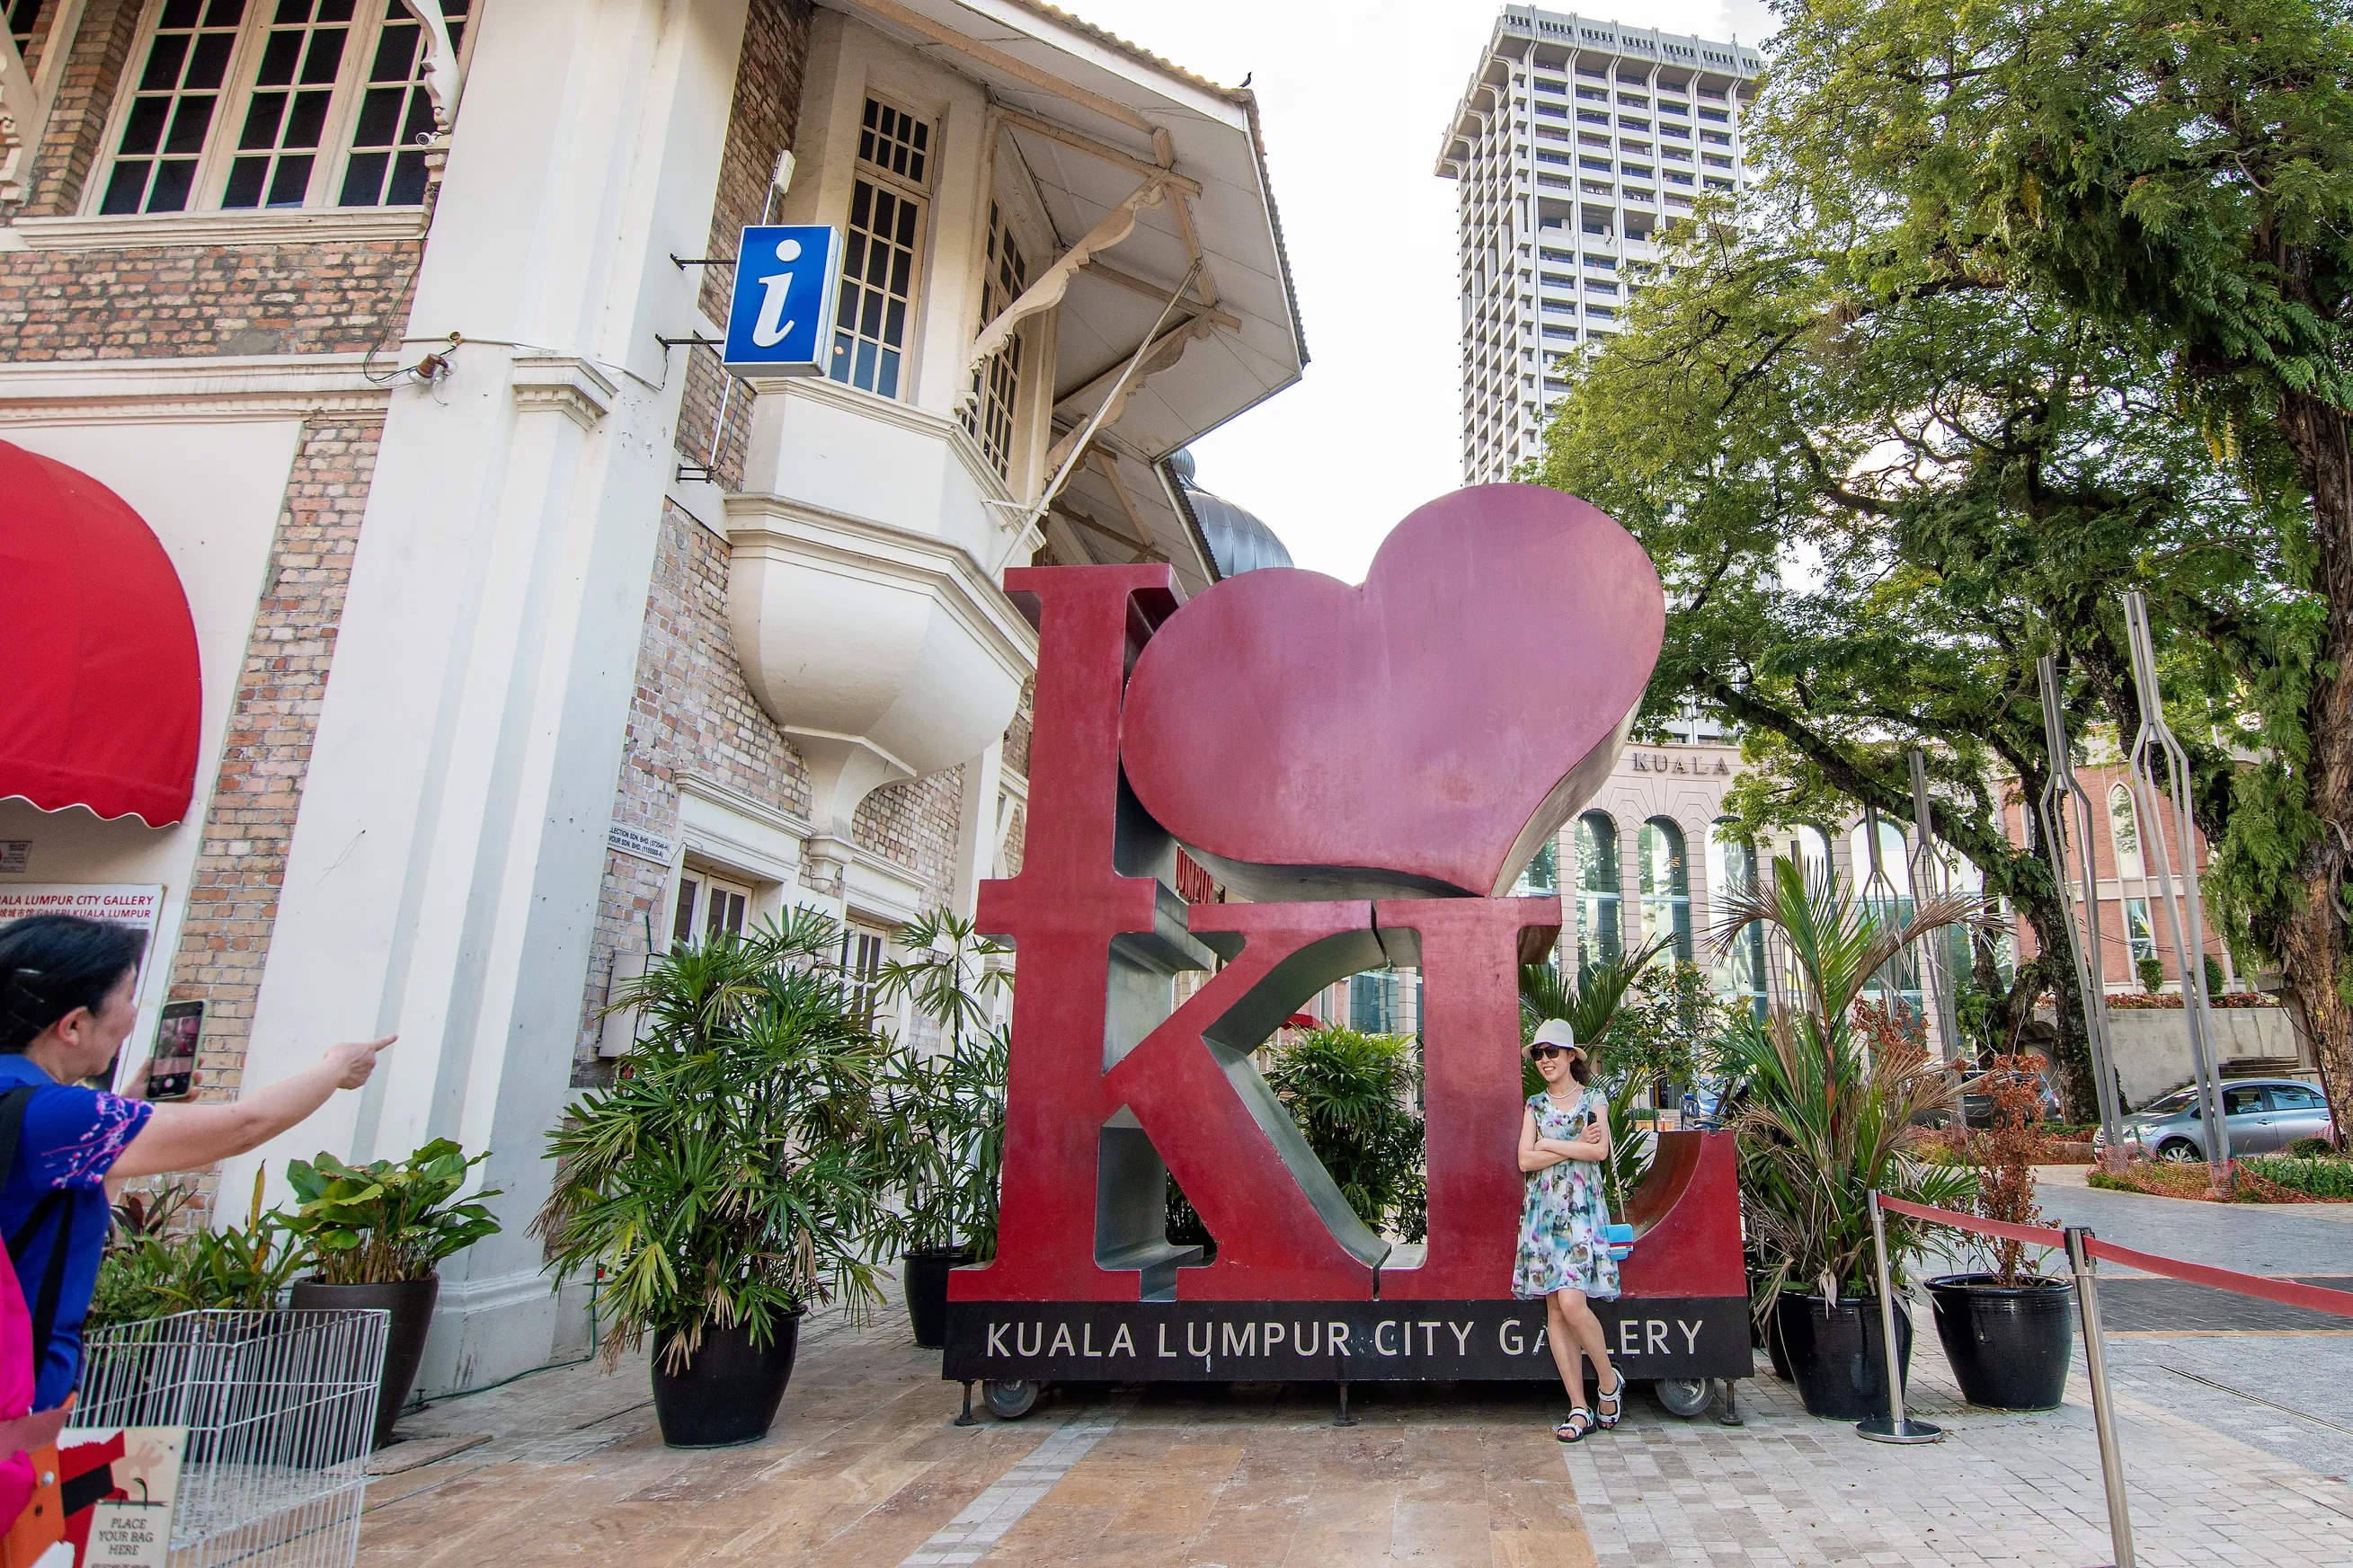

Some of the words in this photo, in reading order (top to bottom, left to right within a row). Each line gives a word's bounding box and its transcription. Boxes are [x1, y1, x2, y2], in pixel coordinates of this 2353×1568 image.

[1633, 752, 1731, 775] KUALA
[0, 895, 22, 905] ALA
[25, 895, 74, 905] LUMPUR
[76, 895, 102, 906] CITY
[103, 895, 155, 906] GALLERY
[73, 908, 105, 917] KUALA
[108, 909, 151, 917] LUMPUR
[987, 1322, 1136, 1357] KUALA
[1159, 1321, 1351, 1358] LUMPUR
[1374, 1320, 1474, 1356] CITY
[111, 1517, 147, 1529] PLACE
[99, 1530, 129, 1542] YOUR
[130, 1531, 154, 1543] BAG
[108, 1544, 139, 1555] HERE
